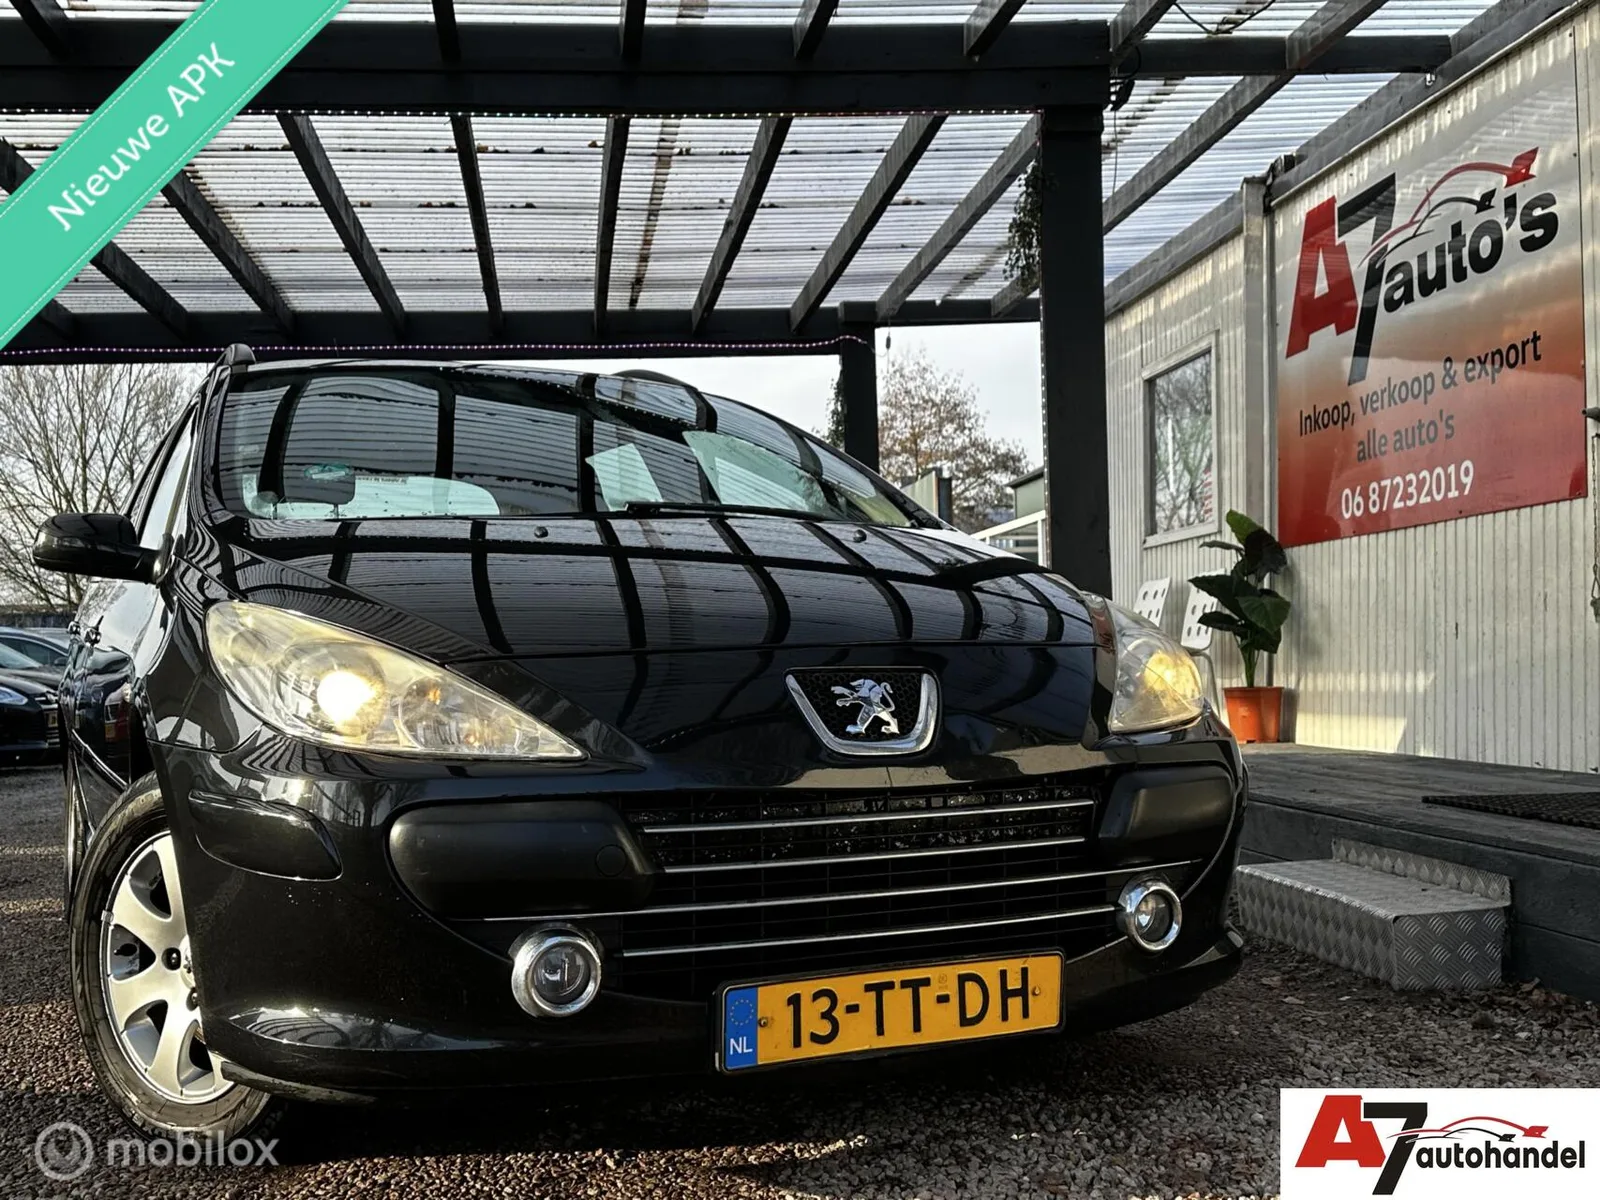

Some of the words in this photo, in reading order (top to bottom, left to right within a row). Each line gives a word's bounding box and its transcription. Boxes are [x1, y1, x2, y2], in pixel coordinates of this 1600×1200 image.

[1383, 192, 1559, 314] auto's
[1299, 399, 1356, 437] Inkoop,
[1360, 376, 1436, 416] verkoop
[1441, 356, 1458, 390] &
[1464, 330, 1542, 384] export
[1356, 429, 1388, 463] alle
[1392, 409, 1456, 452] auto's
[1341, 487, 1365, 520] 06
[1368, 459, 1475, 512] 87232019
[786, 966, 1031, 1049] 13-TT-DH
[729, 1036, 754, 1056] NL
